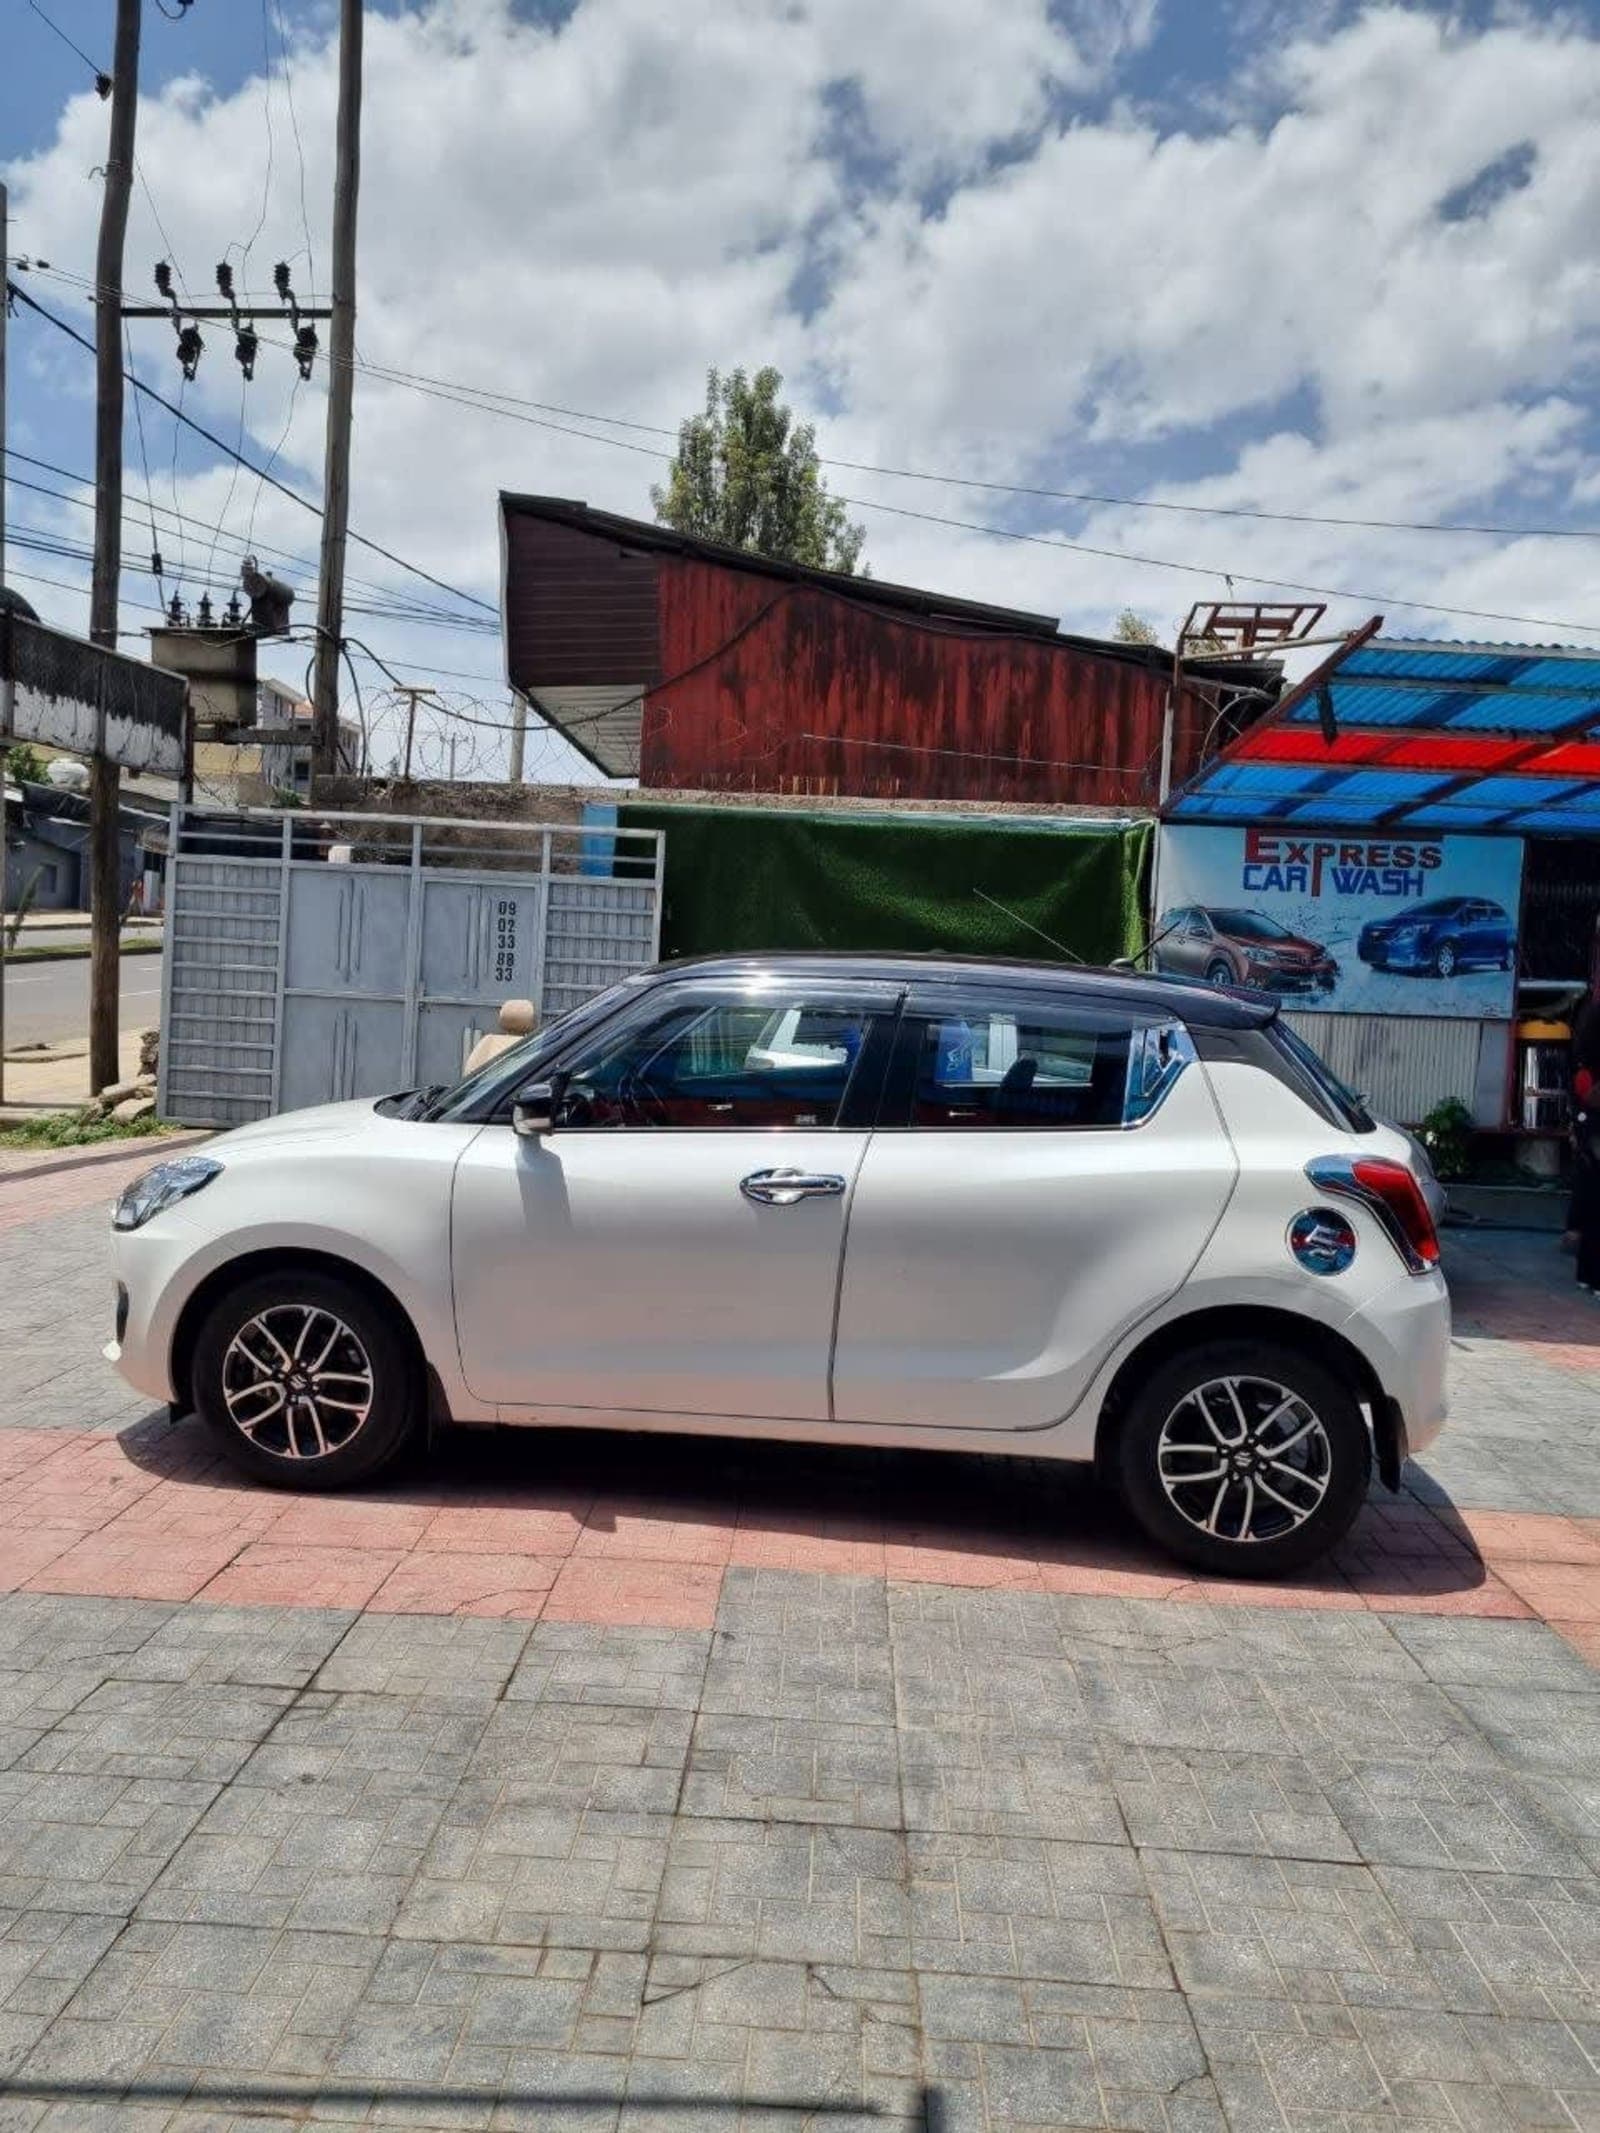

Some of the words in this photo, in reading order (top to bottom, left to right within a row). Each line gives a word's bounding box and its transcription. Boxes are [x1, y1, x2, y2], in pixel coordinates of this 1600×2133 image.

[1245, 827, 1443, 897] EXPRESS
[1243, 864, 1308, 893] CAR
[1331, 867, 1425, 897] WASH
[499, 901, 516, 915] 09
[498, 918, 515, 932] 02
[498, 934, 515, 949] 33
[497, 952, 514, 966] 88
[496, 967, 513, 981] 33
